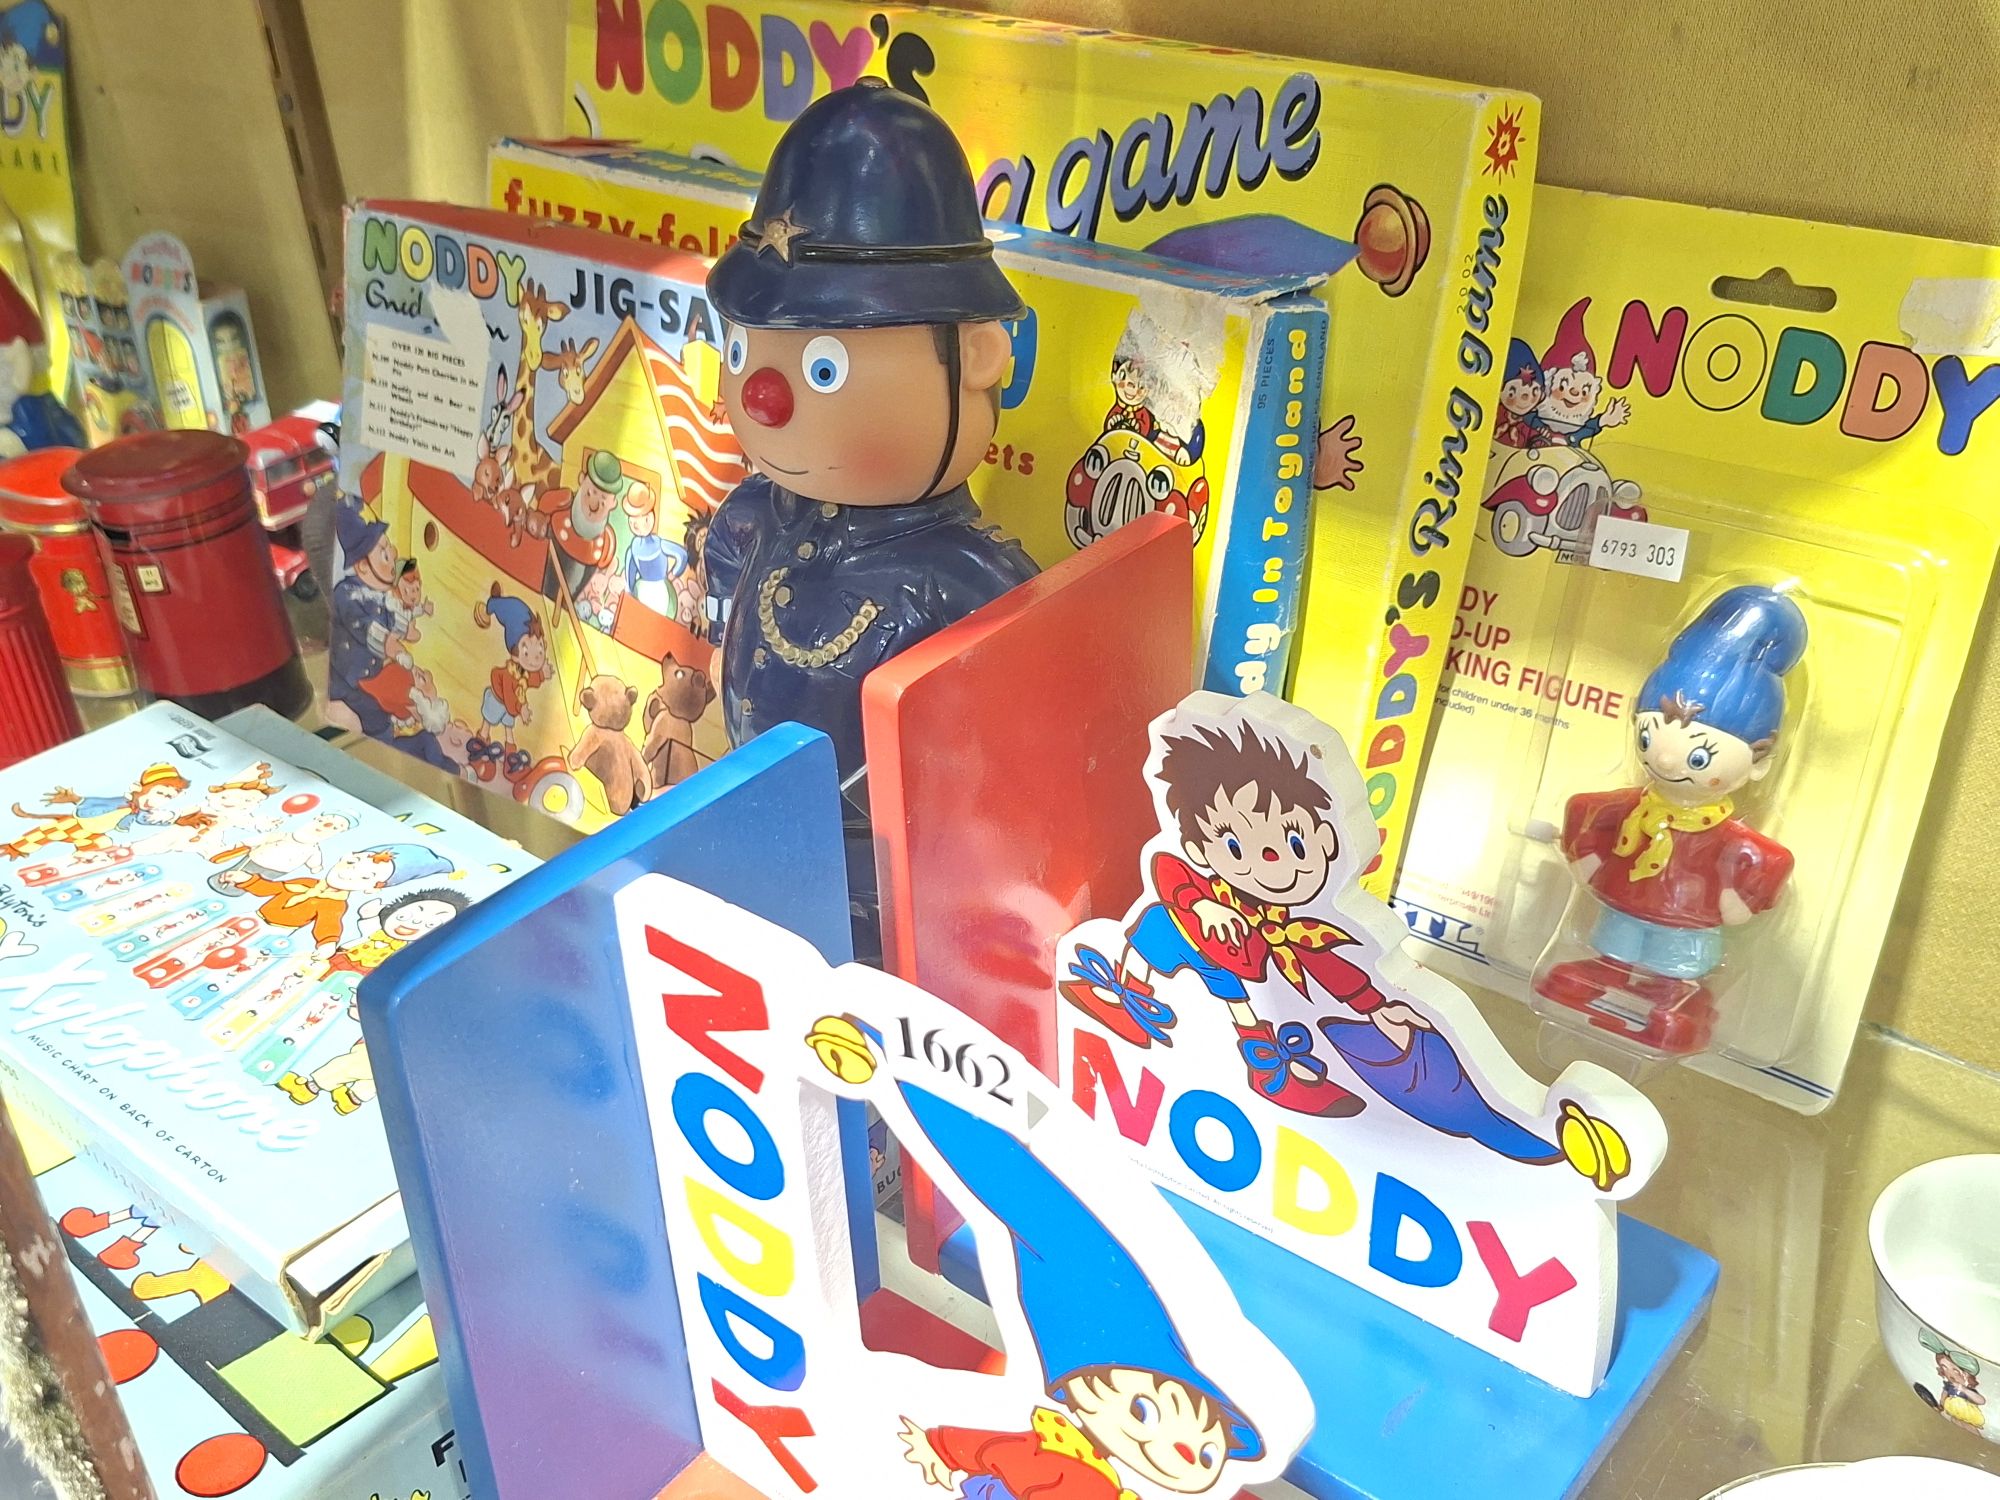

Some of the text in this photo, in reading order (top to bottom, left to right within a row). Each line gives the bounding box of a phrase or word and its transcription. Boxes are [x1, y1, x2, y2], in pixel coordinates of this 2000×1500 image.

[595, 0, 936, 122] NODDY'S
[1046, 71, 1322, 242] game
[363, 217, 527, 309] NODDY
[569, 267, 729, 344] JIG-SA
[1256, 338, 1276, 409] 95 PIECES
[1262, 329, 1308, 542] Toyland
[1408, 386, 1484, 558] Ring
[1457, 193, 1508, 377] game
[1606, 299, 2000, 457] NODDY
[1460, 585, 1499, 616] DY
[1600, 539, 1637, 558] 6793
[1646, 544, 1675, 567] 303
[1444, 646, 1624, 720] KING FIGURE
[1451, 688, 1489, 706] children
[1490, 698, 1519, 715] under
[1519, 706, 1533, 719] 36
[0, 952, 321, 1153] Xylophone
[28, 1033, 228, 1184] MUSIC CHART ON BACK OF CARTON
[895, 1016, 1015, 1107] 1662
[644, 924, 819, 1495] NODDY
[1071, 1027, 1578, 1343] NODDY
